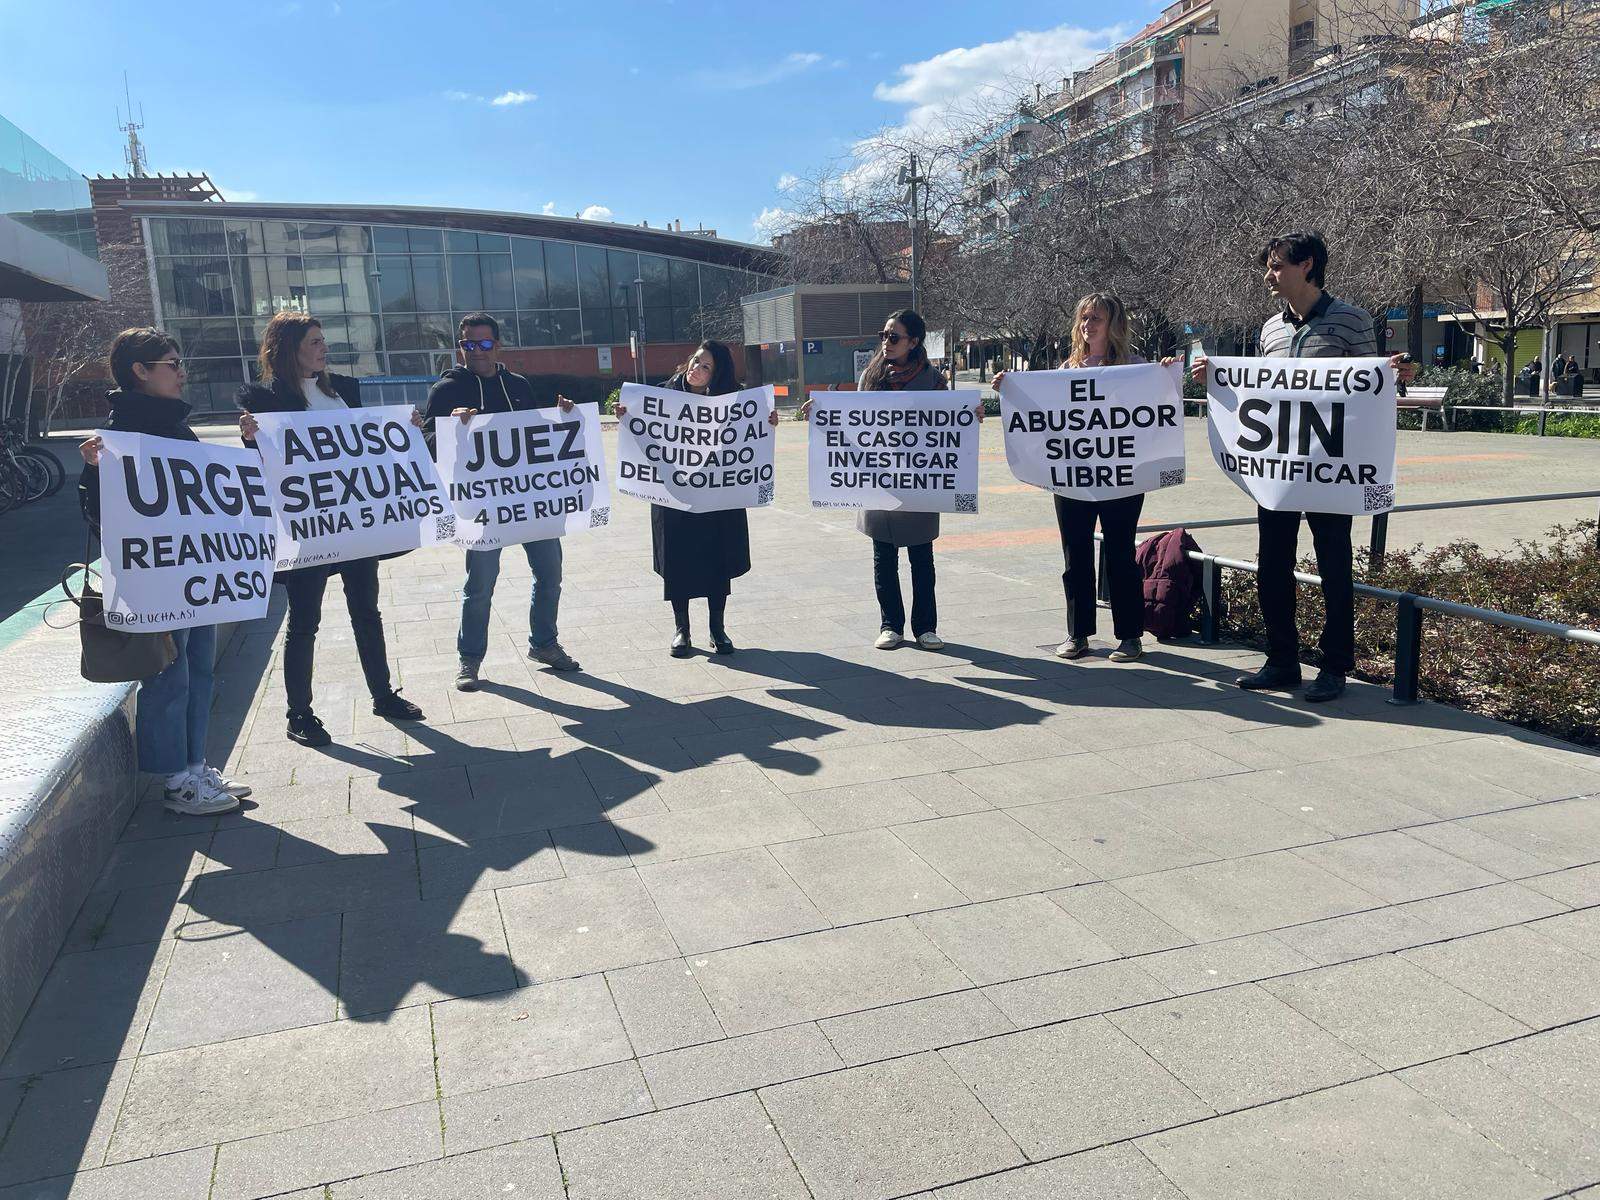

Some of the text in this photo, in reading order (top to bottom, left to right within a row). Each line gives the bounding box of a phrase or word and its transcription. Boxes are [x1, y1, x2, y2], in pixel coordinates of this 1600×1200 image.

[808, 342, 815, 353] P
[1070, 379, 1105, 402] EL
[1214, 366, 1384, 396] CULPABLE(S)
[643, 396, 758, 423] EL ABUSO
[815, 405, 974, 427] SE SUSPENDIÓ
[1008, 404, 1178, 433] ABUSADOR
[629, 417, 768, 446] OCURRIÓ AL
[826, 431, 961, 448] EL CASO SIN
[1236, 398, 1345, 458] SIN
[284, 421, 411, 465] ABUSO
[465, 420, 586, 473] JUEZ
[645, 443, 755, 468] CUIDADO
[1045, 435, 1136, 460] SIGUE
[620, 460, 773, 489] DEL COLEGIO
[828, 451, 958, 470] INVESTIGAR
[1220, 452, 1378, 485] IDENTIFICAR
[122, 455, 273, 518] URGE
[280, 461, 438, 514] SEXUAL
[450, 462, 600, 502] INSTRUCCIÓN
[830, 472, 956, 490] SUFICIENTE
[1050, 464, 1135, 488] LIBRE
[290, 494, 445, 541] NIÑA 5 AÑOS
[474, 489, 584, 526] 4 DE RUBÍ
[122, 533, 276, 570] REANUDAR
[184, 571, 267, 606] CASO
[125, 609, 196, 626] @LUCHA.ASI
